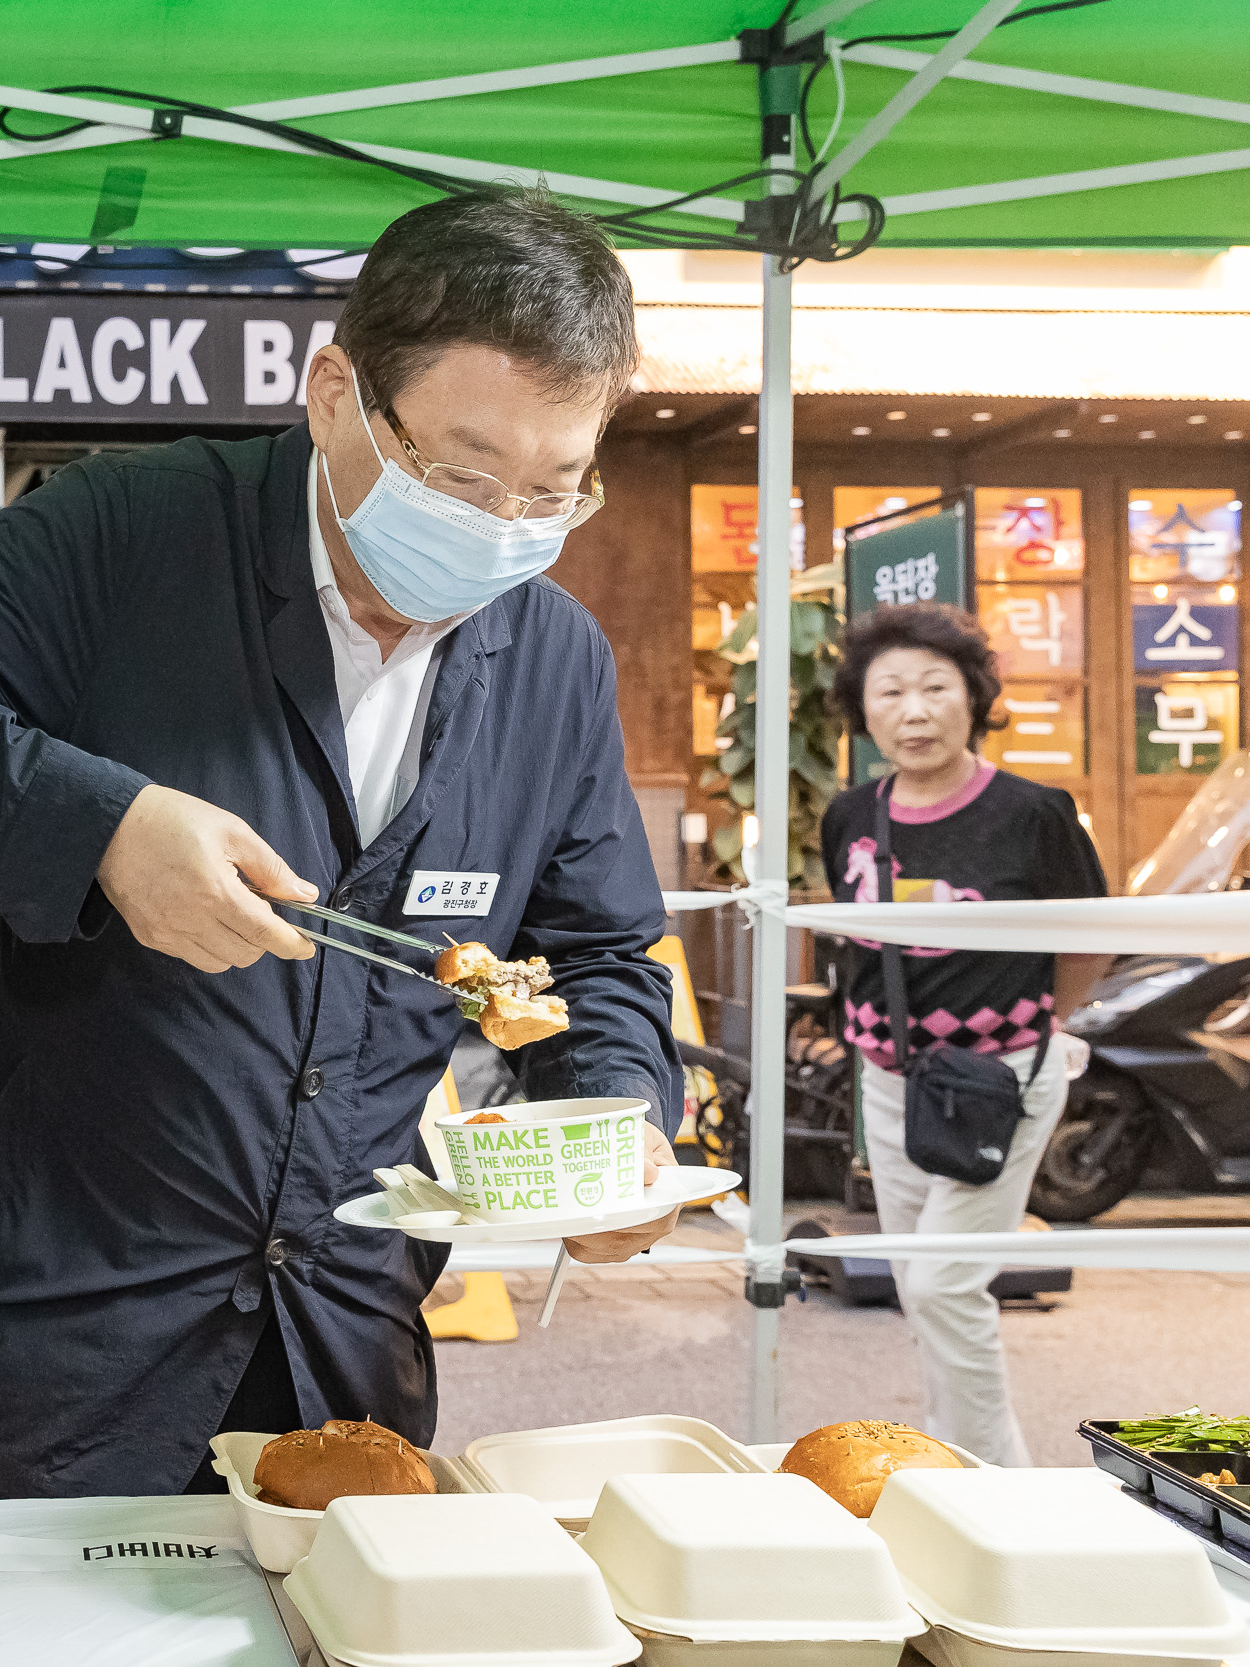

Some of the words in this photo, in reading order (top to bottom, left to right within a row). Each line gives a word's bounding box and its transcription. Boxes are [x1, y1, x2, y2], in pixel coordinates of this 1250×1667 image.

[442, 899, 478, 909] 광진구청장
[473, 1128, 551, 1151] MAKE
[561, 1139, 611, 1160] GREEN
[446, 1130, 465, 1185] GREEN
[453, 1131, 475, 1186] HELLO
[476, 1156, 499, 1169] THE
[504, 1153, 554, 1168] WORLD
[562, 1158, 611, 1174] TOGETHER
[615, 1116, 636, 1199] GREEN
[482, 1174, 491, 1187] A
[494, 1170, 556, 1187] BETTER
[484, 1188, 559, 1210] PLACE
[83, 1541, 220, 1561] 처비버디
